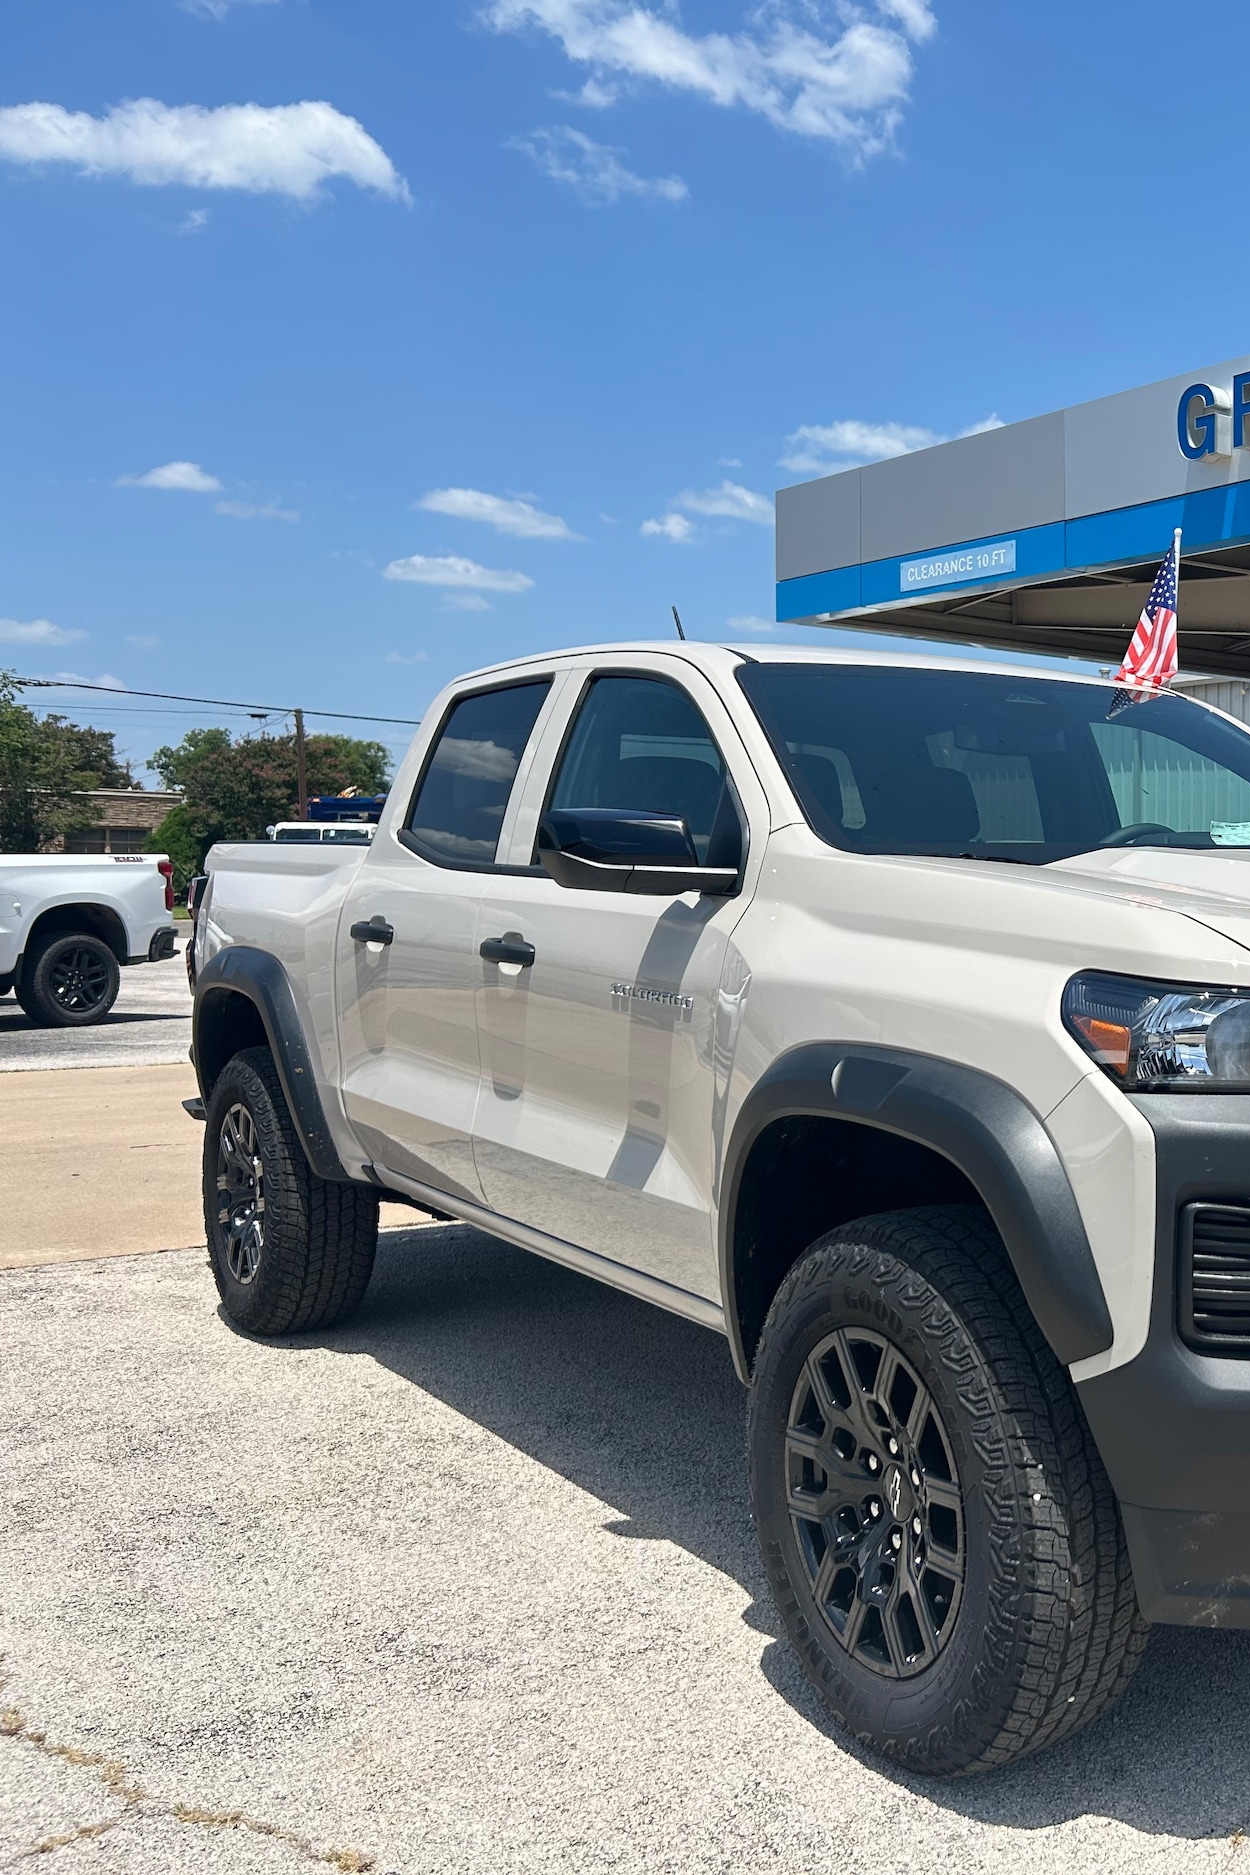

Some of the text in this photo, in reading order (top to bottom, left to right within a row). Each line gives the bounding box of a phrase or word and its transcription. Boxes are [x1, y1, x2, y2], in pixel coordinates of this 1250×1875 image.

[907, 549, 1006, 582] CLEARANCE 10 FT
[610, 983, 694, 1009] COLORADO
